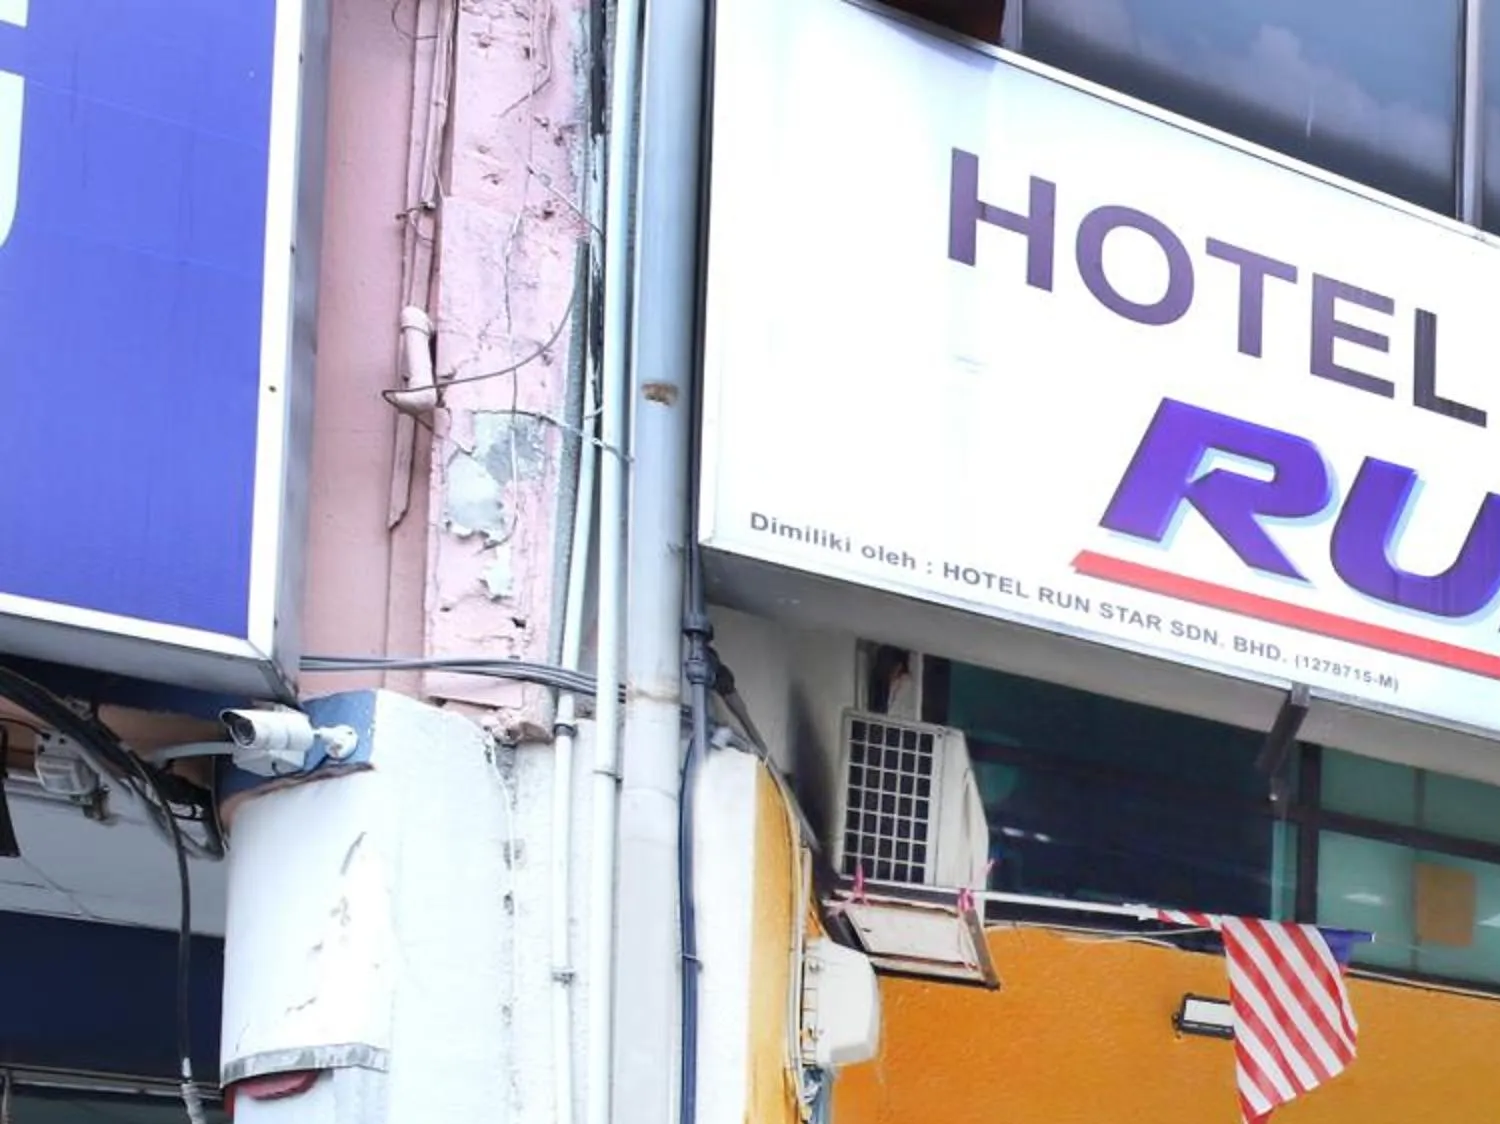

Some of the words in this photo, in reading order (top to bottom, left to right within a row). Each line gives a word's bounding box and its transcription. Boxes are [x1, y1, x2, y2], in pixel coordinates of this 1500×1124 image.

[949, 147, 1487, 428] HOTEL
[749, 512, 851, 553] Dimiliki
[861, 544, 916, 570] oleh
[943, 562, 1030, 600] HOTEL
[1038, 586, 1091, 613] RUN
[1100, 602, 1162, 632] STAR
[1170, 620, 1225, 649] SDN.
[1233, 635, 1287, 663] BHD.
[1295, 653, 1400, 692] (1278715-M)
